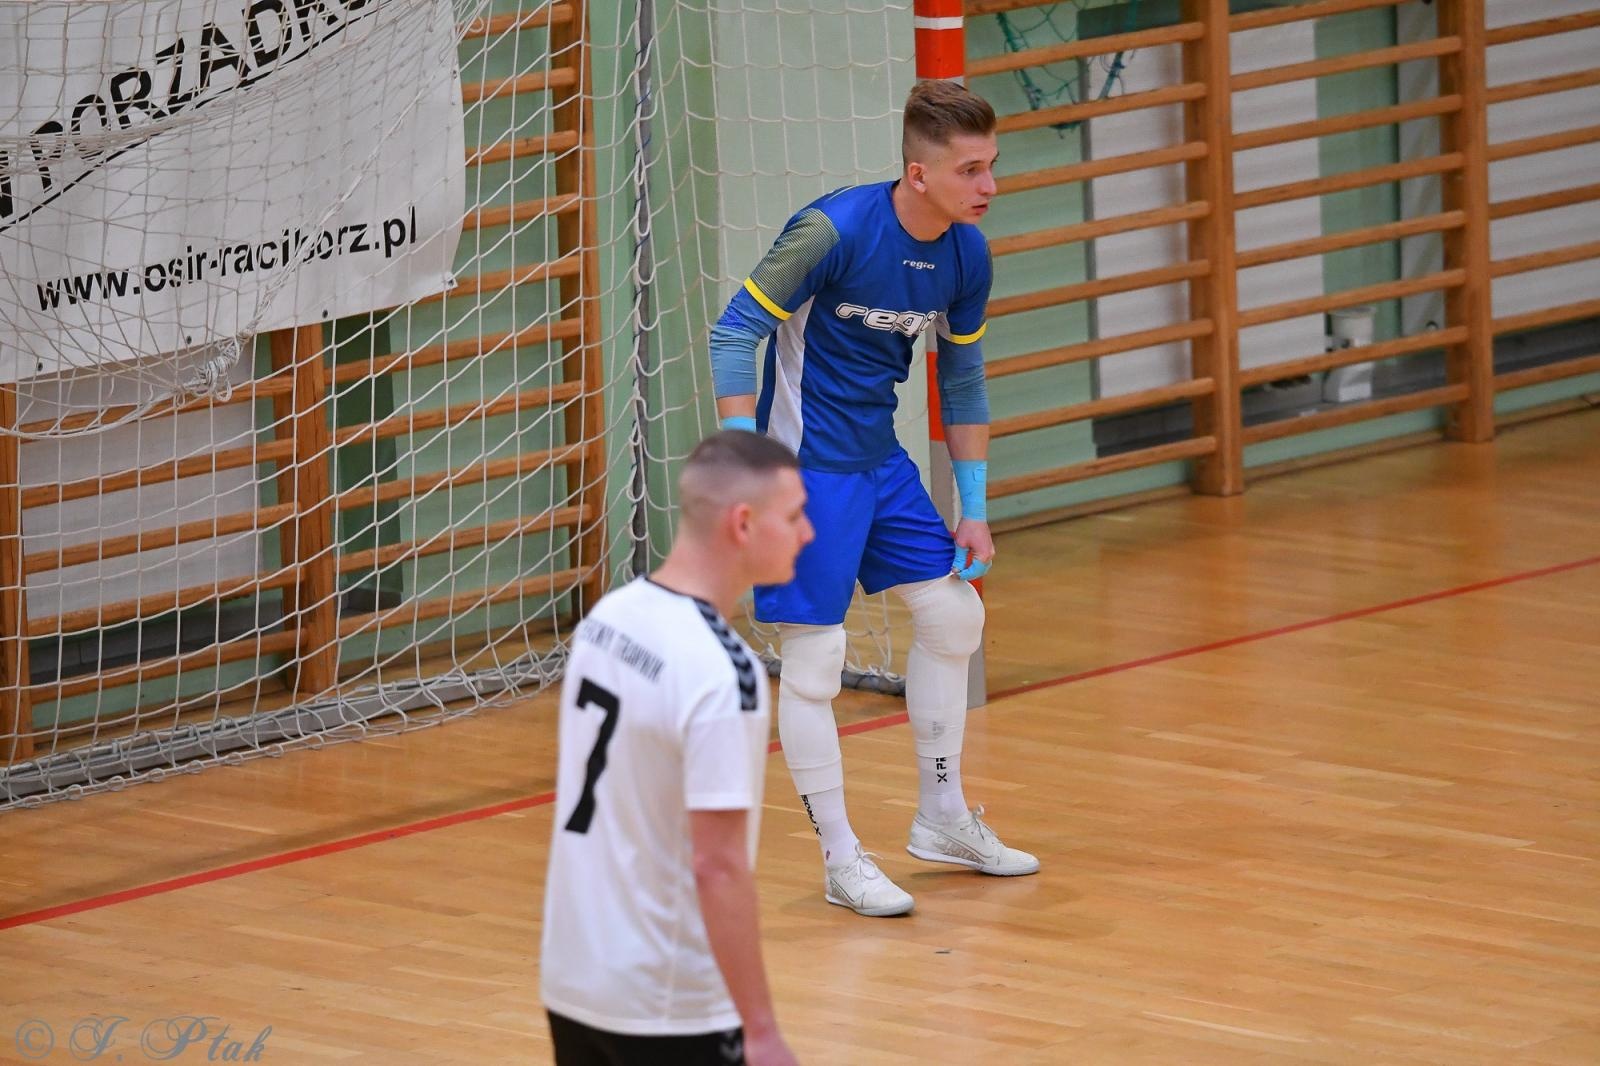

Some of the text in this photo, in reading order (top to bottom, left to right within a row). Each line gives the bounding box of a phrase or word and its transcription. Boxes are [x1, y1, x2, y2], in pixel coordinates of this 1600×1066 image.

[37, 205, 416, 311] www.osir-raciborz.pl
[903, 259, 935, 270] regio
[836, 303, 938, 337] regi
[565, 677, 620, 834] 7
